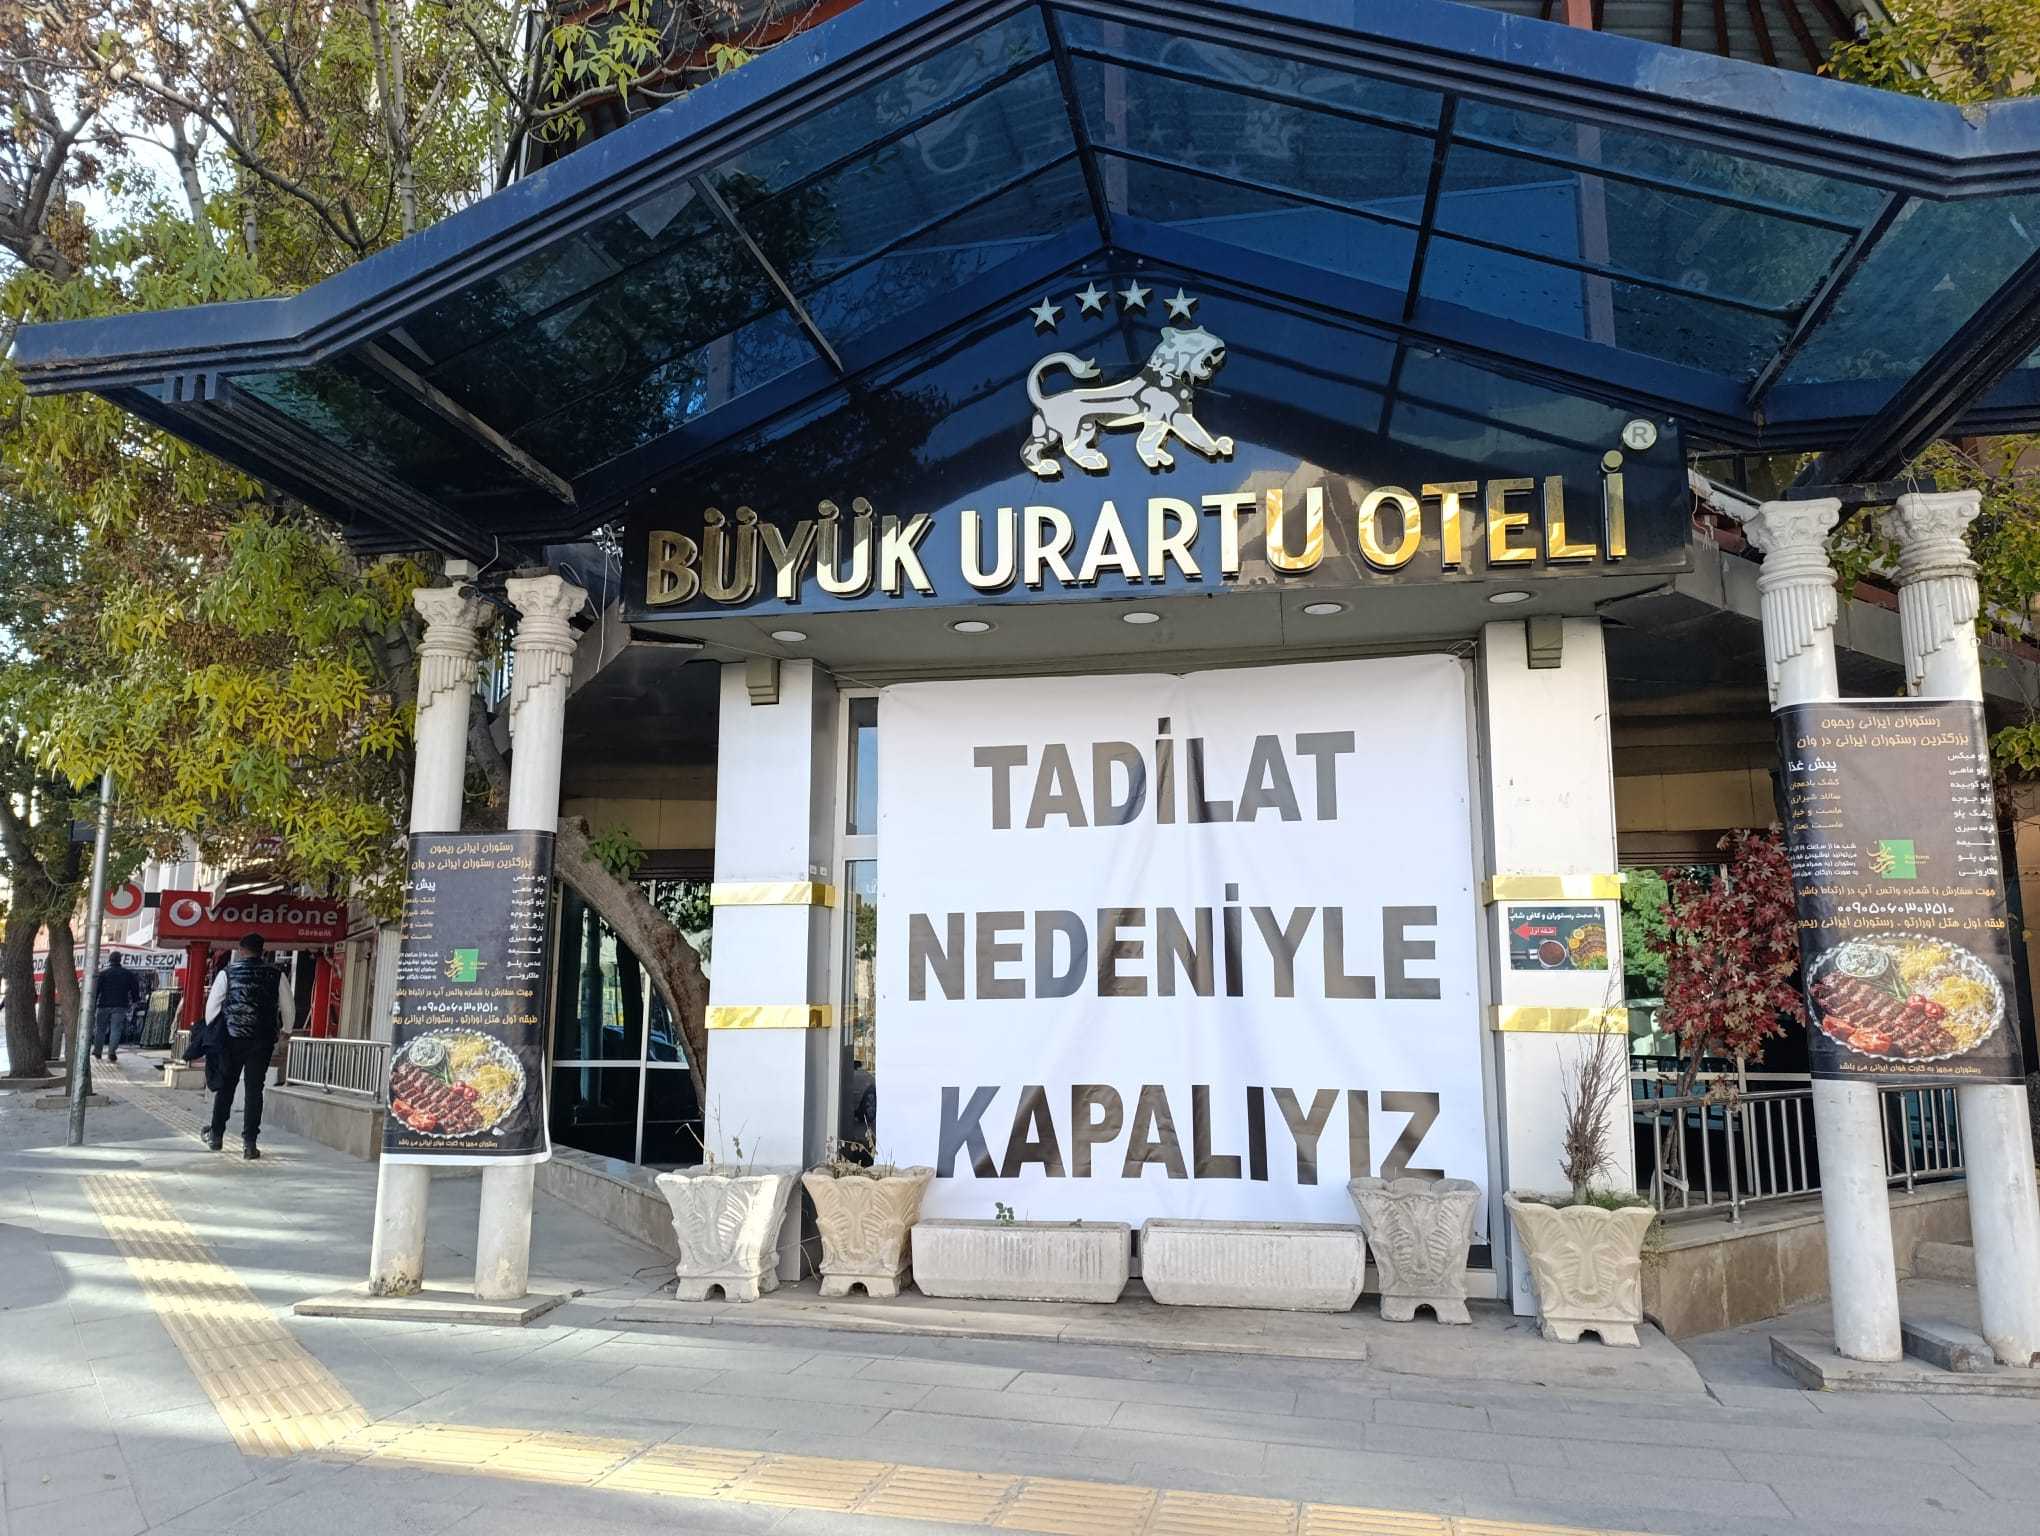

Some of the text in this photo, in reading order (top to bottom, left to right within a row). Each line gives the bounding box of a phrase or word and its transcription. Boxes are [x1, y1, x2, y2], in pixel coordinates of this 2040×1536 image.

[646, 450, 1626, 606] BÜYÜK URARTU OTELİ
[1859, 716, 1890, 729] ایرانی
[1895, 716, 1941, 728] رستوران
[1797, 732, 1969, 748] بزرگترین رستوران ایرانی در وان
[1788, 756, 1837, 773] پیش غذا
[973, 716, 1355, 830] TADİLAT
[456, 842, 479, 854] ایرانی
[482, 842, 514, 853] رستوران
[437, 859, 460, 870] ایرانی
[462, 858, 494, 869] رستوران
[416, 878, 435, 892] پیش
[205, 904, 338, 925] vodafone
[1821, 916, 1850, 928] ایرانی
[1853, 917, 1894, 928] رستوران
[1938, 918, 1960, 929] هتل
[908, 883, 1441, 1001] NEDENİYLE
[145, 953, 182, 966] SEZON
[936, 1084, 1445, 1185] KAPALIYIZ
